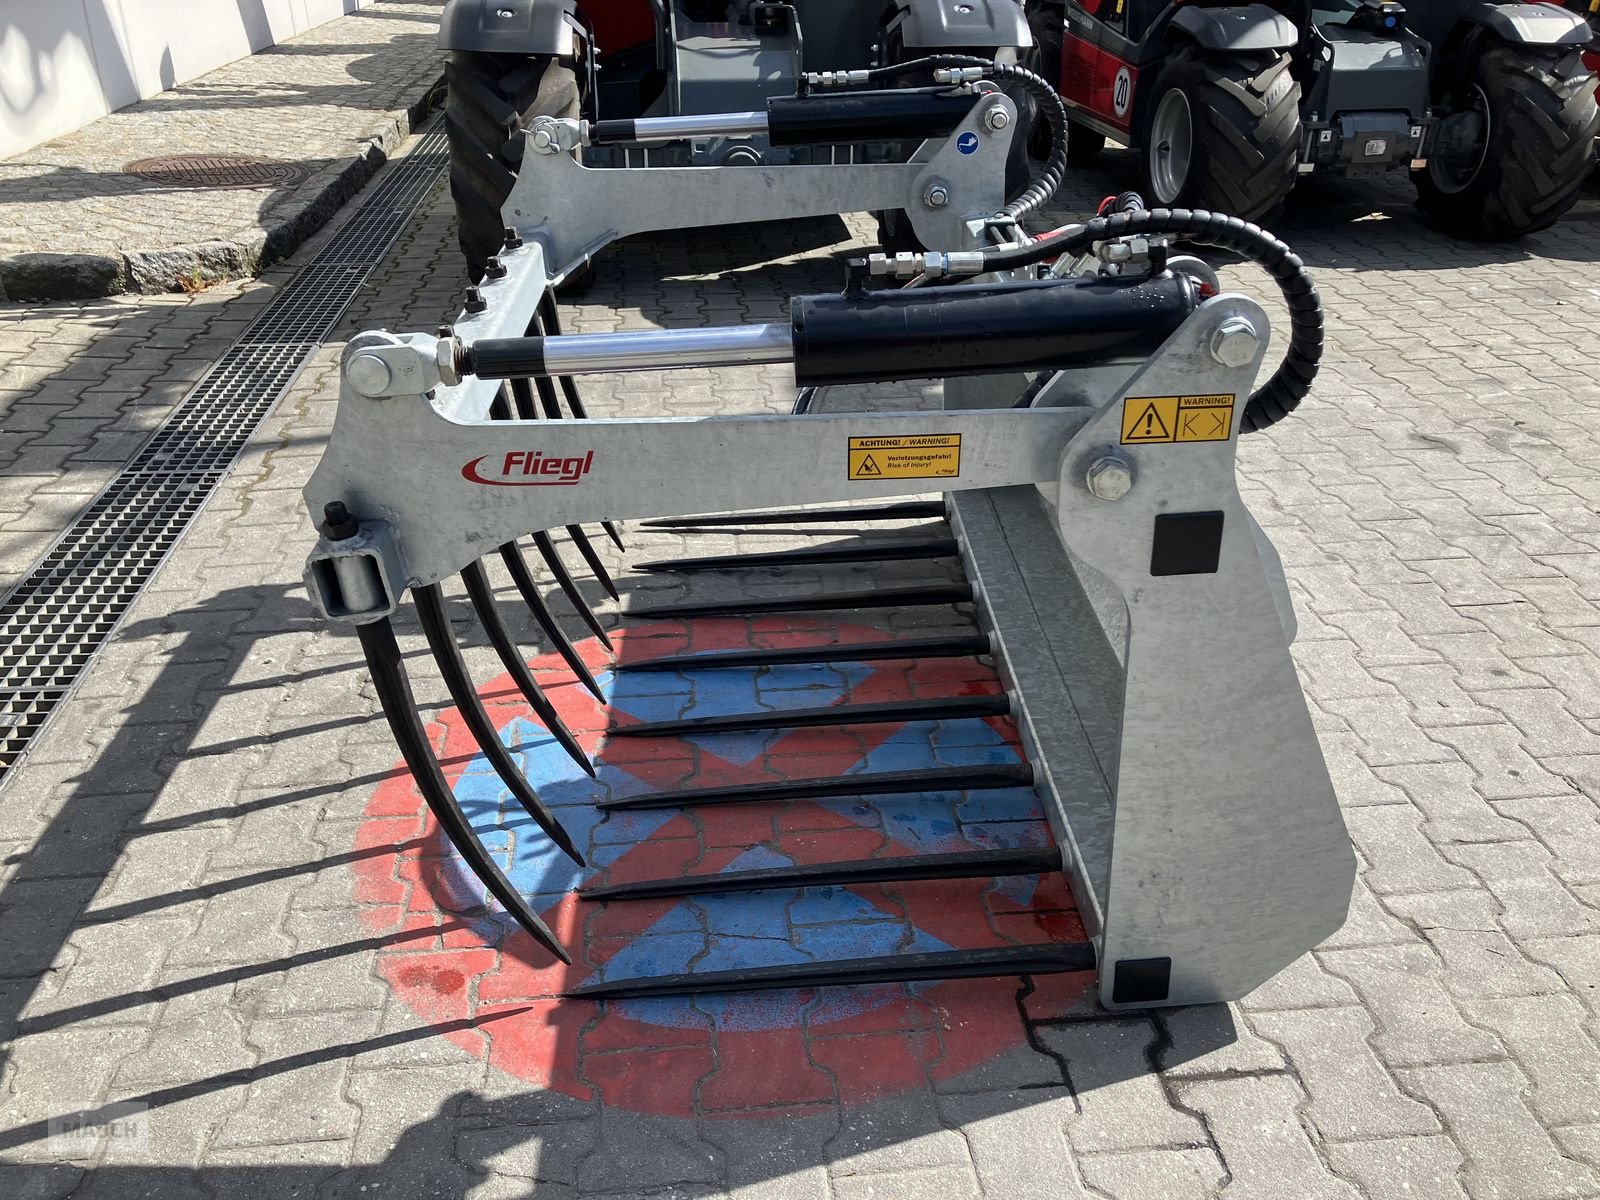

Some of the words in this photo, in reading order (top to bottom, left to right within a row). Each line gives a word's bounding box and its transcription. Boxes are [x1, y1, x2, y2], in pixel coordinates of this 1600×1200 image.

[1116, 75, 1128, 109] 20
[1184, 397, 1231, 406] WARNING!
[502, 450, 594, 481] Fliegl
[887, 453, 952, 461] Verletzungsgefahr!
